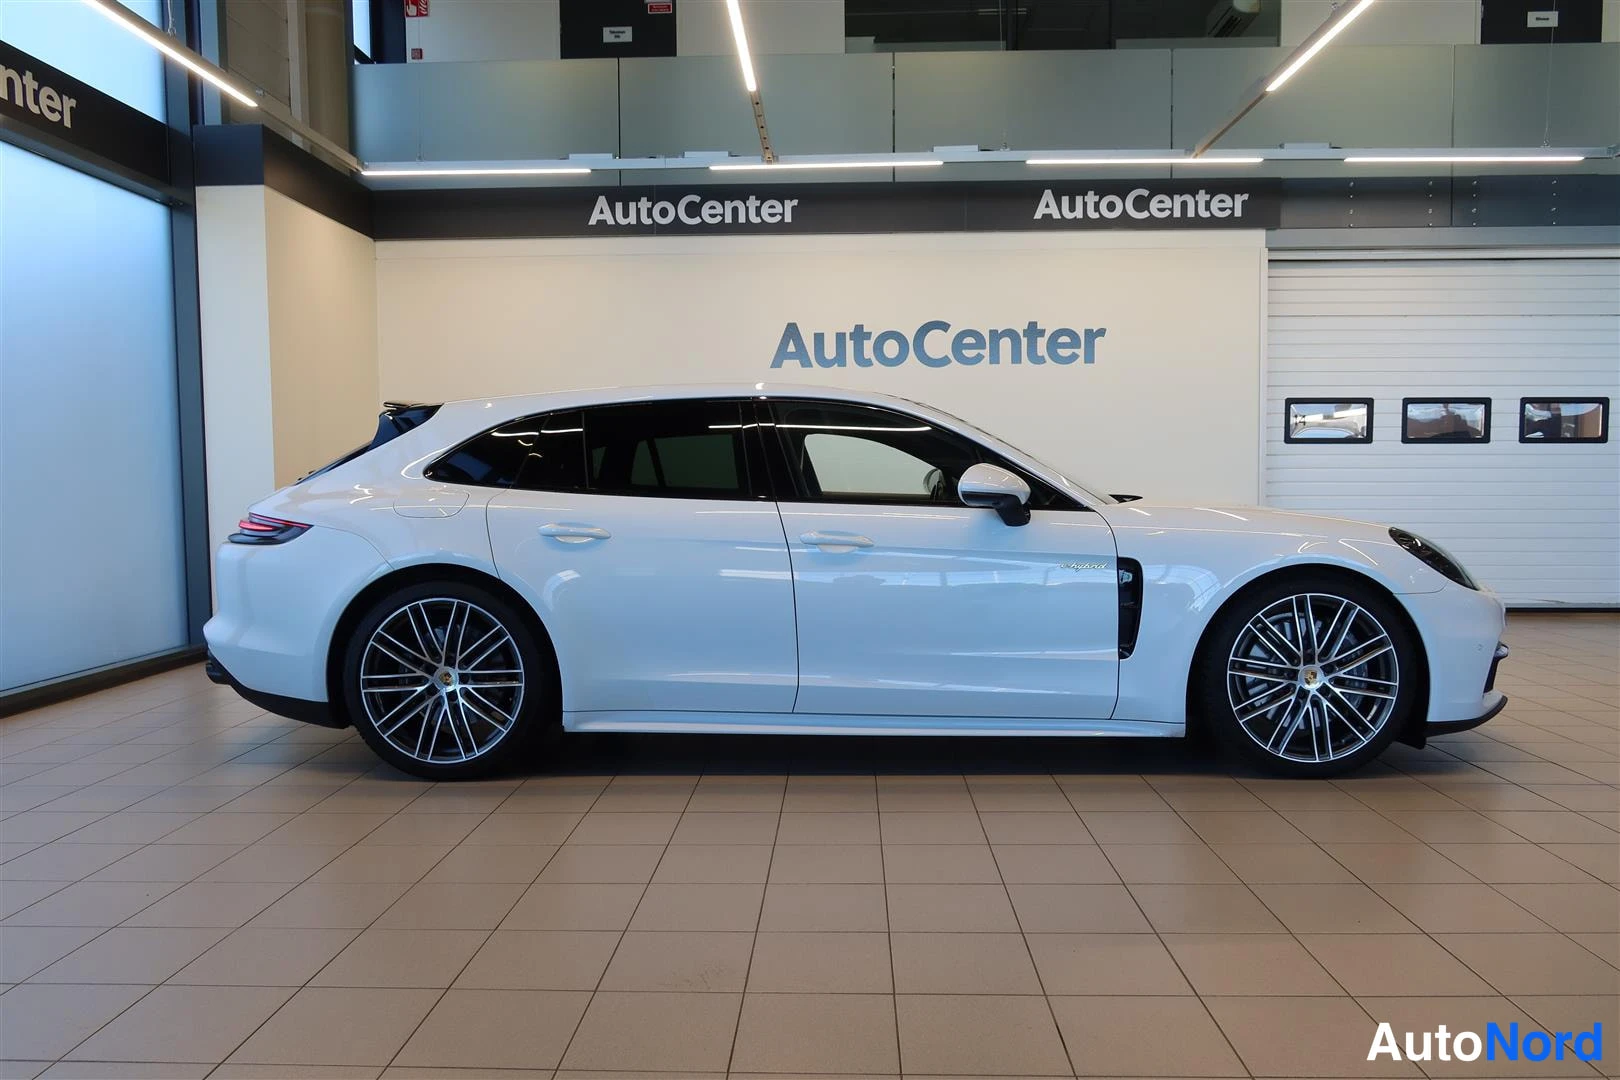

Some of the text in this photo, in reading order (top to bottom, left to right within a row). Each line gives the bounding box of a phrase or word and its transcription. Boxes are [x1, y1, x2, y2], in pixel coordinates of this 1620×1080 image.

[588, 194, 798, 226] AutoCenter
[1033, 188, 1249, 220] AutoCenter
[769, 320, 1107, 368] AutoCenter
